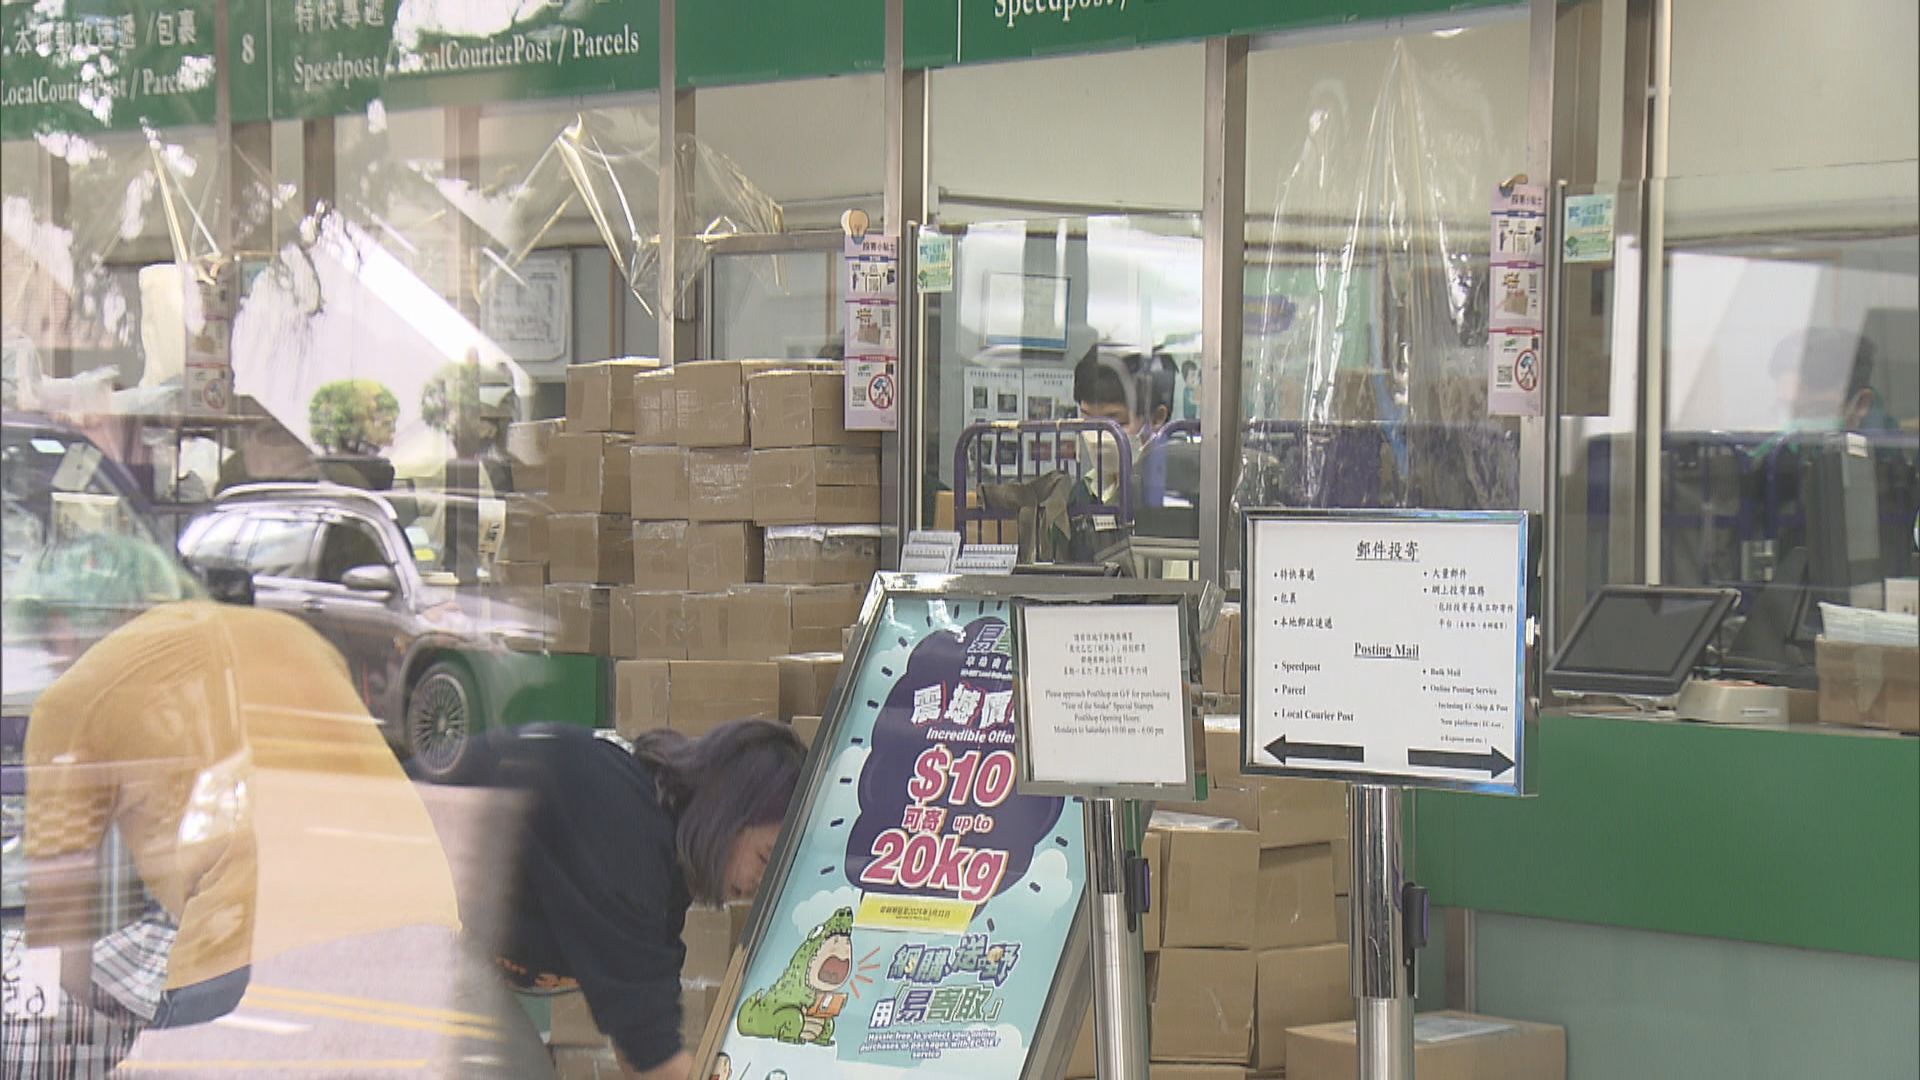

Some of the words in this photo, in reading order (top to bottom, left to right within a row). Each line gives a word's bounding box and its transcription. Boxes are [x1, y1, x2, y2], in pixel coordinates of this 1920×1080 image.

[241, 34, 255, 64] 8
[294, 52, 379, 92] Speedpost
[558, 27, 567, 65] /
[573, 24, 639, 58] Parcels
[129, 68, 139, 101] /
[1356, 540, 1420, 561] 郵件投寄
[1280, 568, 1315, 581] 特快專遞
[1433, 567, 1467, 580] 大量郵件
[1280, 616, 1333, 629] 本地郵政速遞
[1354, 642, 1392, 657] Posting
[1395, 643, 1419, 657] Mail
[1281, 660, 1321, 674] Speedpost
[1430, 667, 1445, 676] Bulk
[1447, 668, 1461, 677] Mail
[1063, 689, 1085, 699] approach
[1141, 689, 1170, 700] purchasing
[1282, 683, 1306, 695] Parcel
[1452, 686, 1474, 695] Posting
[1476, 687, 1497, 696] Service
[1282, 708, 1303, 720] Local
[1304, 709, 1335, 722] Courier
[1337, 712, 1354, 722] Post
[926, 727, 986, 743] Incredible
[906, 744, 1017, 807] $10
[901, 804, 946, 834] 可寄
[953, 815, 972, 835] up
[973, 814, 994, 833] to
[860, 829, 1009, 903] 20kg
[867, 1031, 893, 1042] Hassle
[895, 1031, 911, 1042] free
[913, 1030, 921, 1041] to
[923, 1030, 951, 1041] collect
[952, 1031, 970, 1043] your
[970, 1030, 996, 1041] online
[859, 1041, 899, 1054] purchases
[901, 1041, 910, 1051] or
[911, 1040, 949, 1053] packages
[951, 1038, 969, 1049] with
[912, 1050, 941, 1059] service
